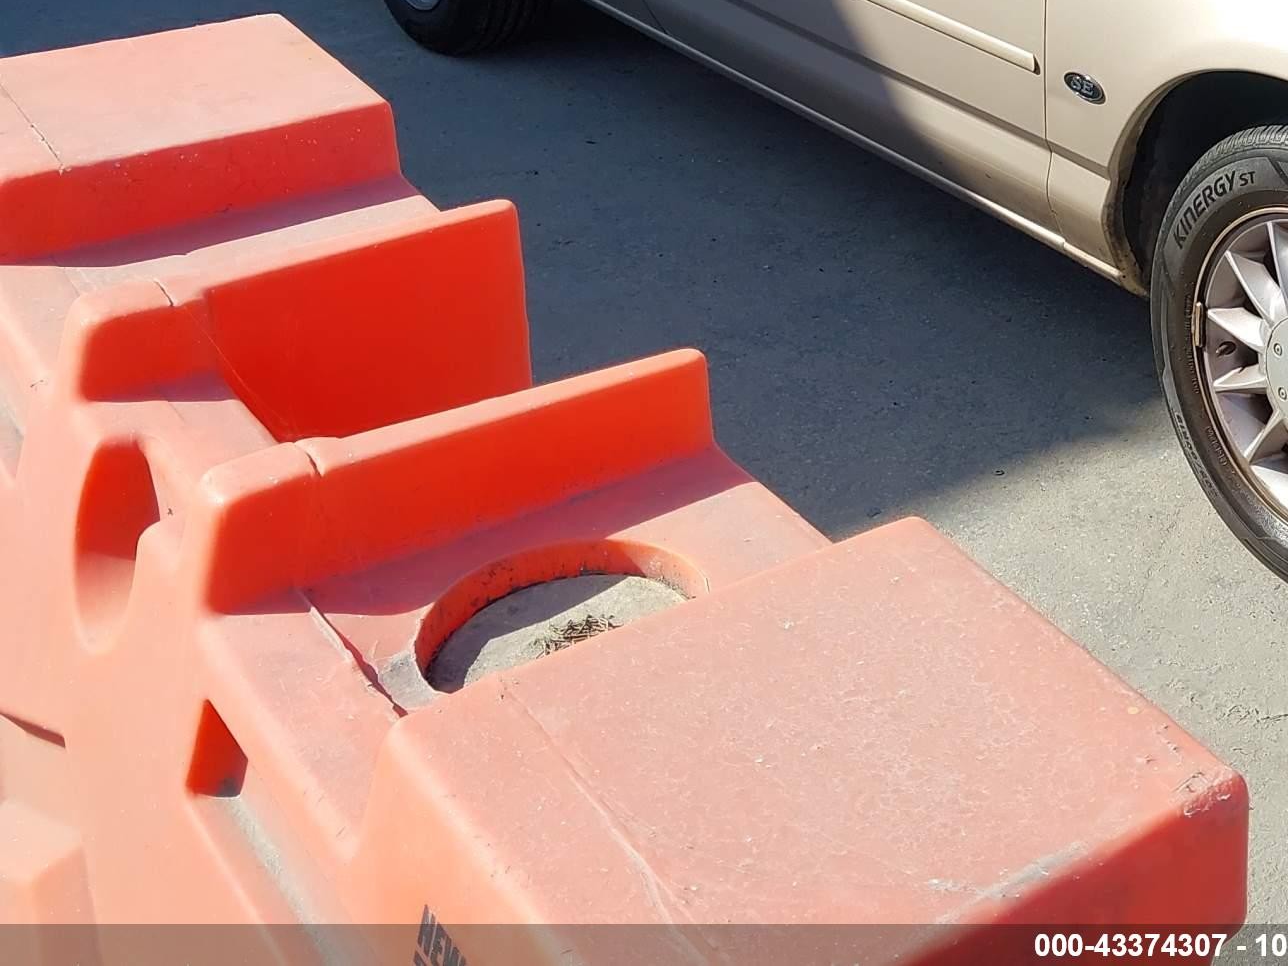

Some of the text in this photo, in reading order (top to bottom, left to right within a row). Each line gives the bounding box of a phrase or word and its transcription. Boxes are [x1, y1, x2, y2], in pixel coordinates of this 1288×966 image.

[1070, 76, 1094, 95] SE
[1173, 170, 1256, 249] KINERGY ST
